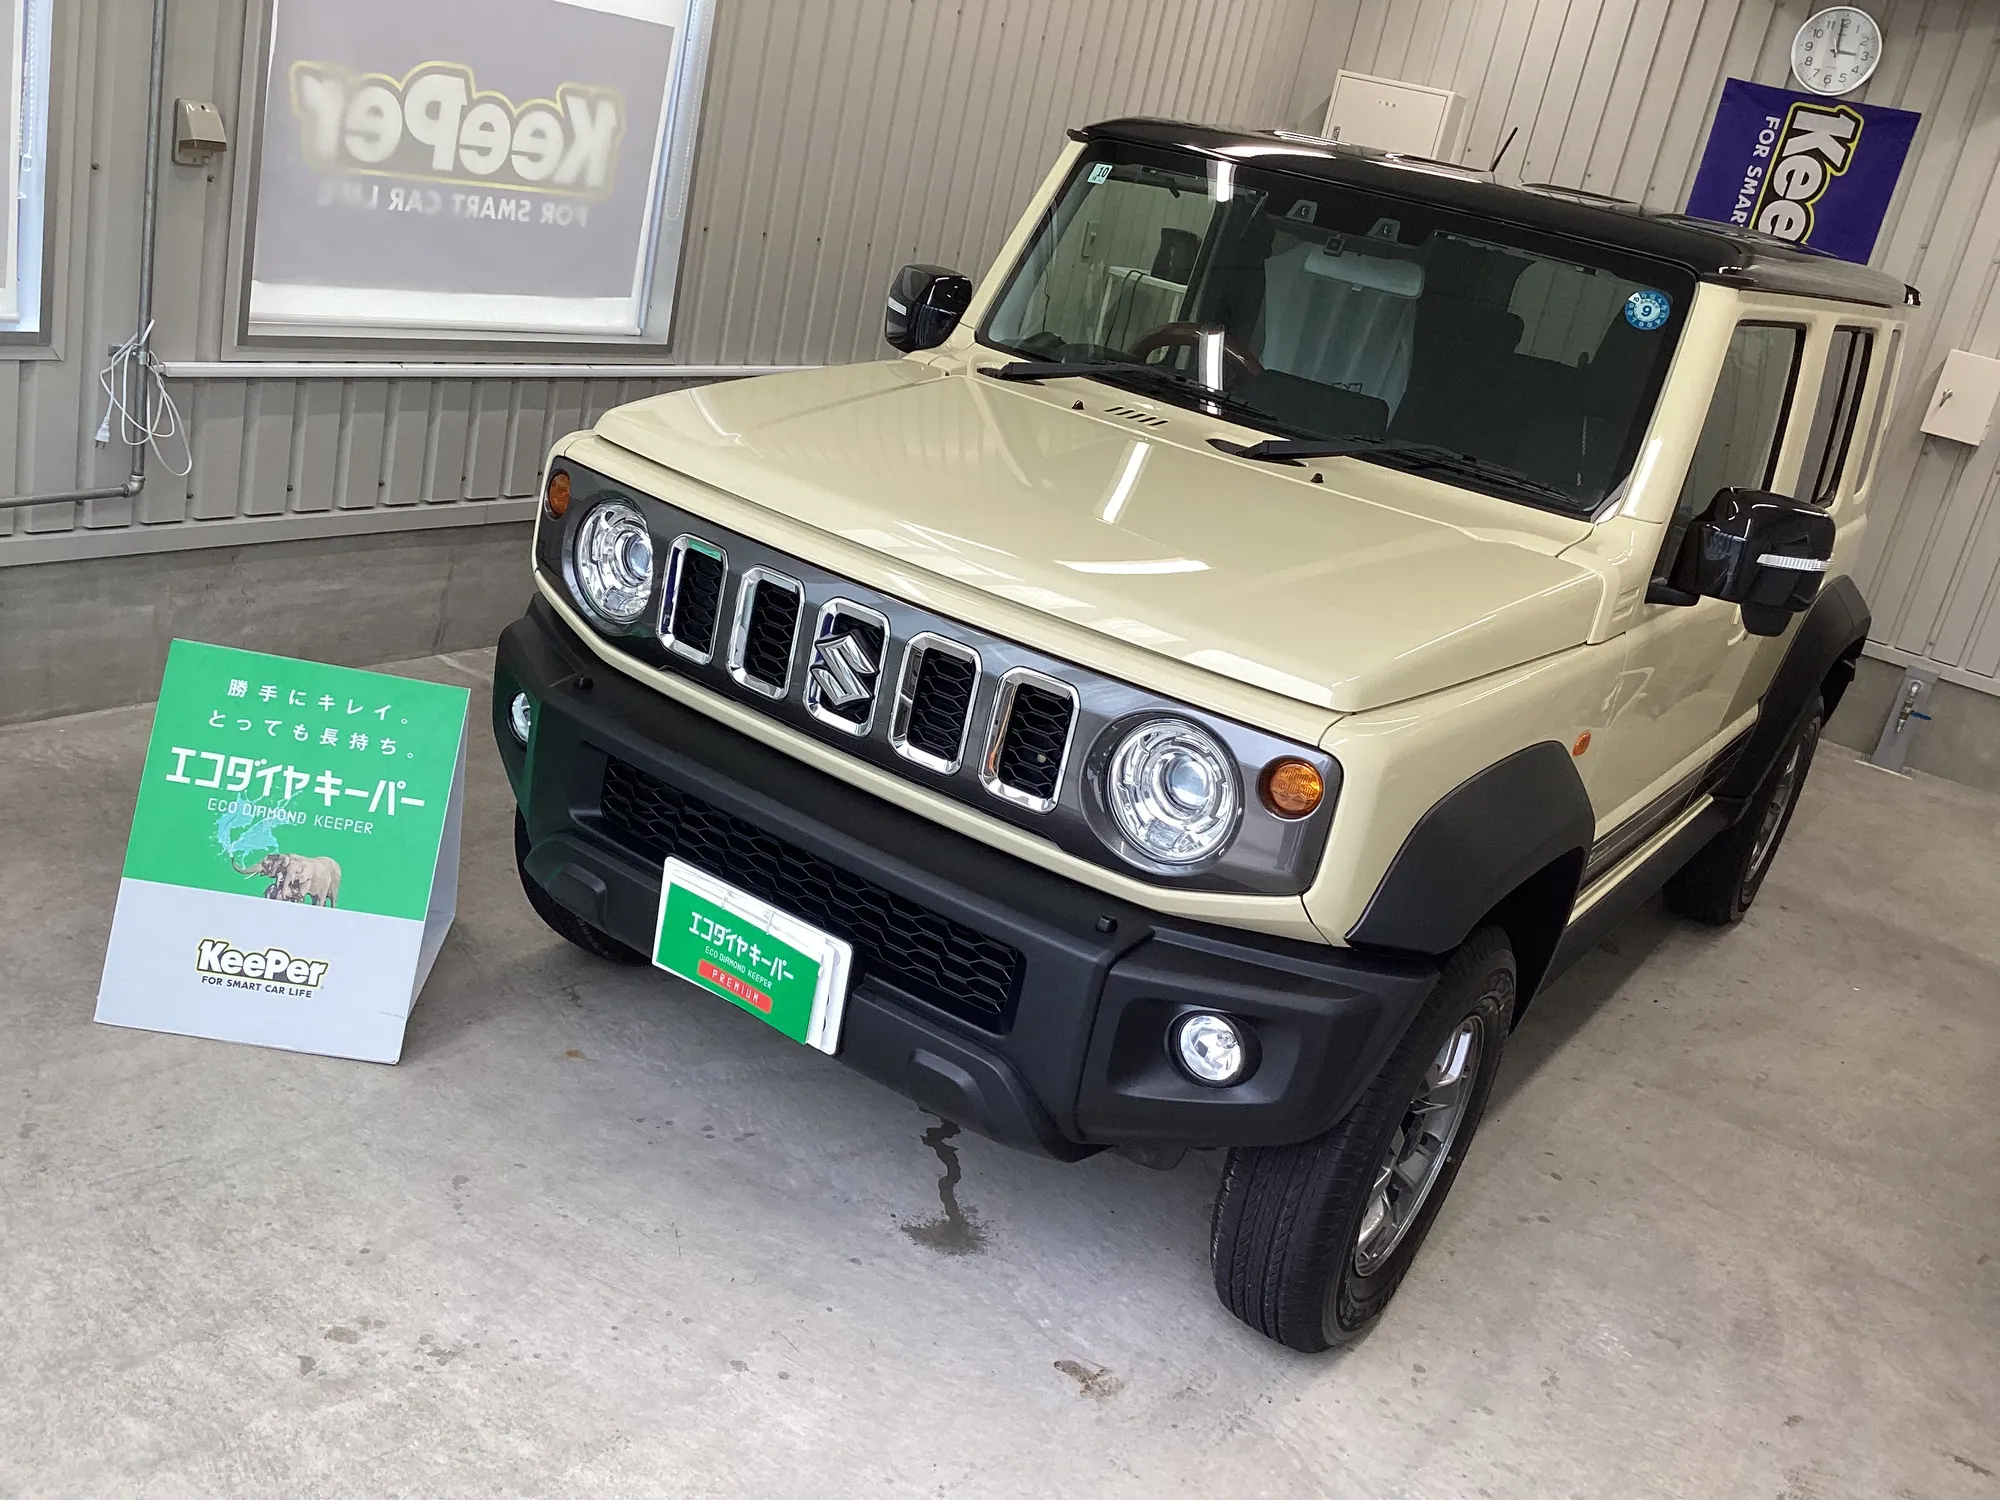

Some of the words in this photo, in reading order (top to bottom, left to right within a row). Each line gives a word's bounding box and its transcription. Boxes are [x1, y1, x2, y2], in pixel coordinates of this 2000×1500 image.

[1753, 115, 1781, 158] FOR
[1096, 166, 1110, 178] 10
[1730, 165, 1762, 228] SMAR
[1641, 305, 1652, 317] 9
[227, 679, 408, 725] 勝手にキレイ。
[208, 709, 414, 759] とっても長持ち。
[165, 746, 425, 816] エコダイヤキーパー
[207, 798, 238, 814] ECO
[242, 804, 307, 825] DIAMOND
[313, 815, 374, 835] KEEPER
[197, 938, 329, 987] KeePer
[688, 911, 794, 982] エコダイヤキーパー
[704, 946, 719, 959] ECO
[719, 952, 746, 974] DIAMOND
[747, 969, 773, 990] KEEPER
[201, 975, 223, 986] FOR
[226, 979, 262, 992] SMART
[264, 984, 285, 995] CAR
[288, 988, 313, 999] LIFE
[711, 969, 760, 1003] PREMIUM
